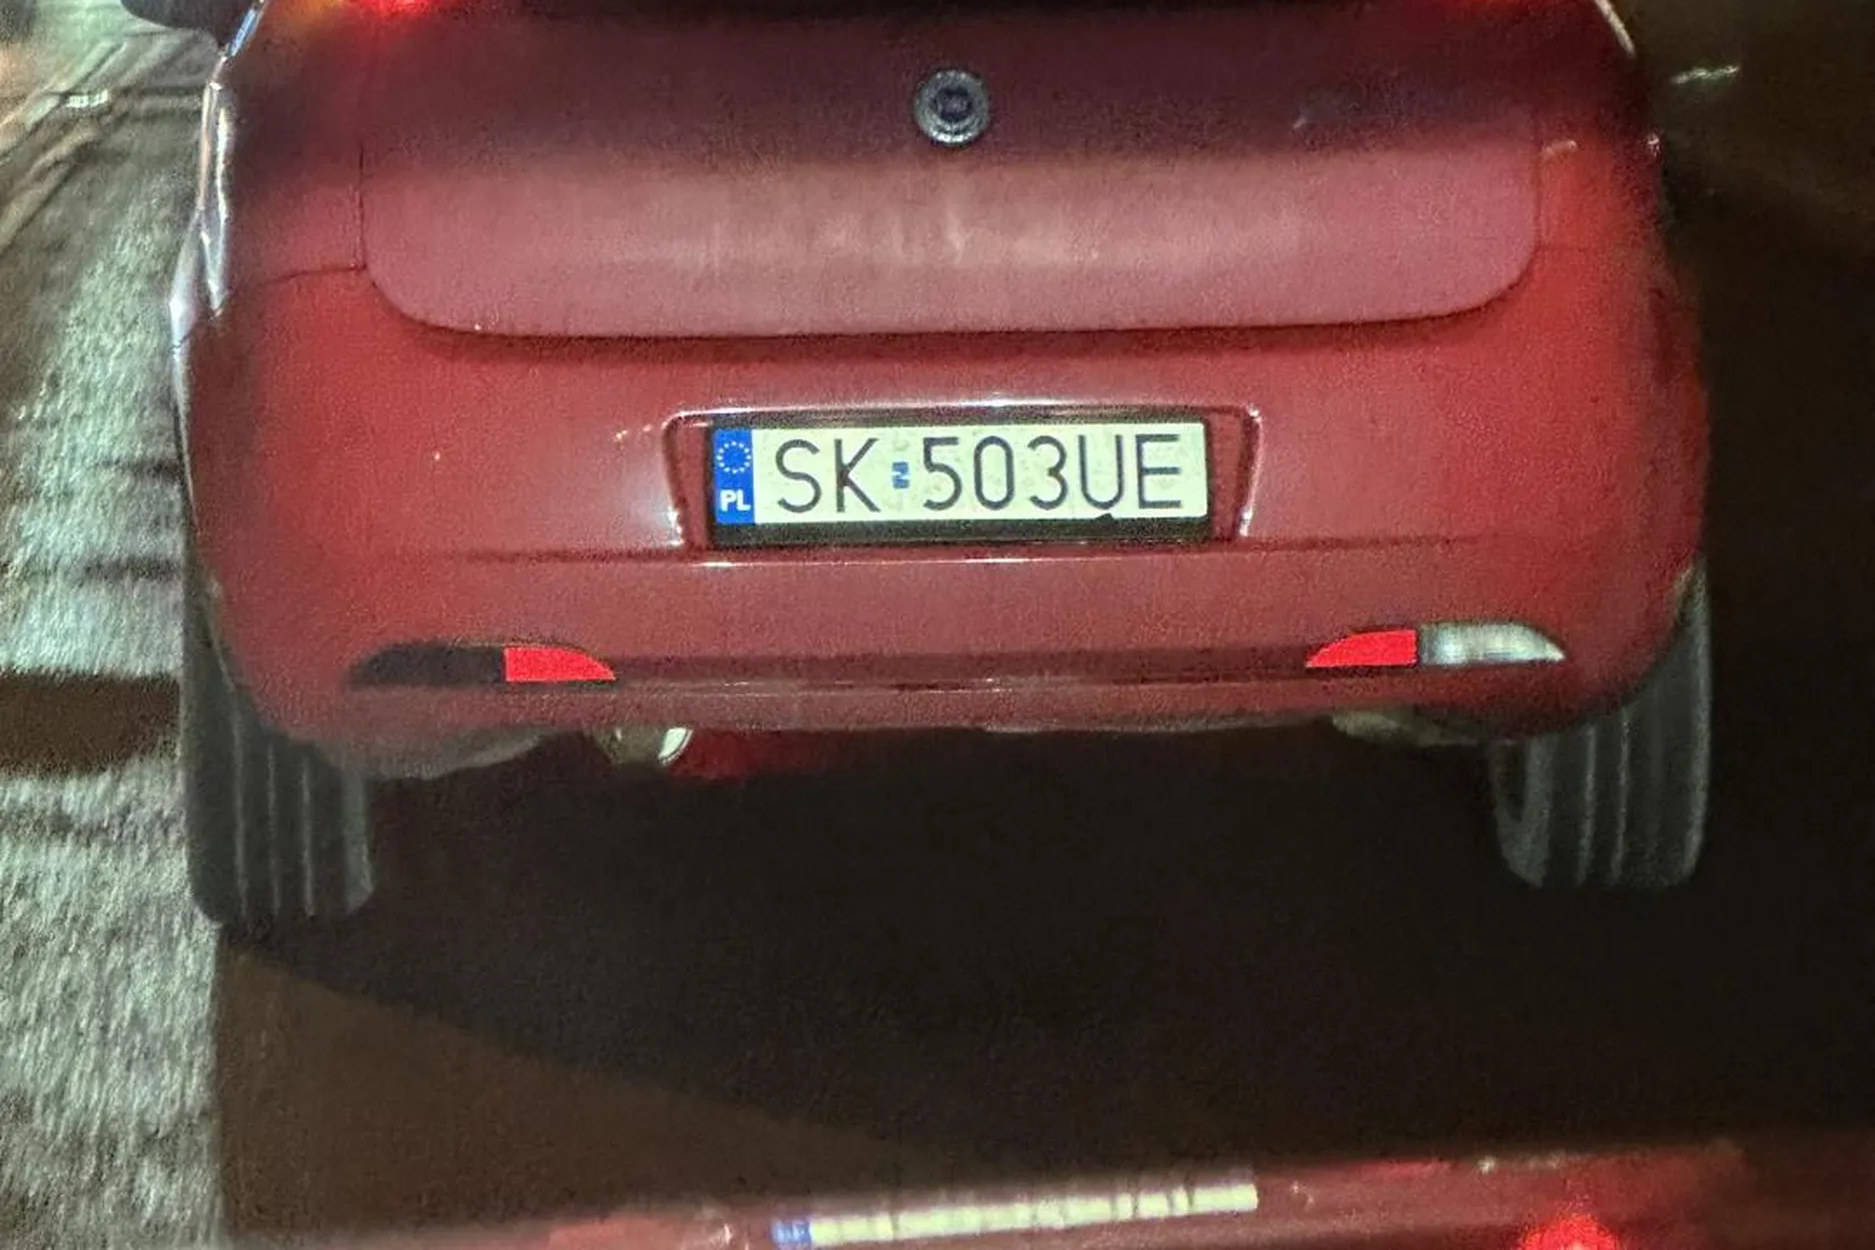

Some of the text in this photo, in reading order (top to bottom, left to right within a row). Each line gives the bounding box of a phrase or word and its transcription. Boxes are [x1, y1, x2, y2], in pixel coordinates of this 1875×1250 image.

[775, 433, 1183, 513] SK 503UE
[720, 489, 751, 512] PL
